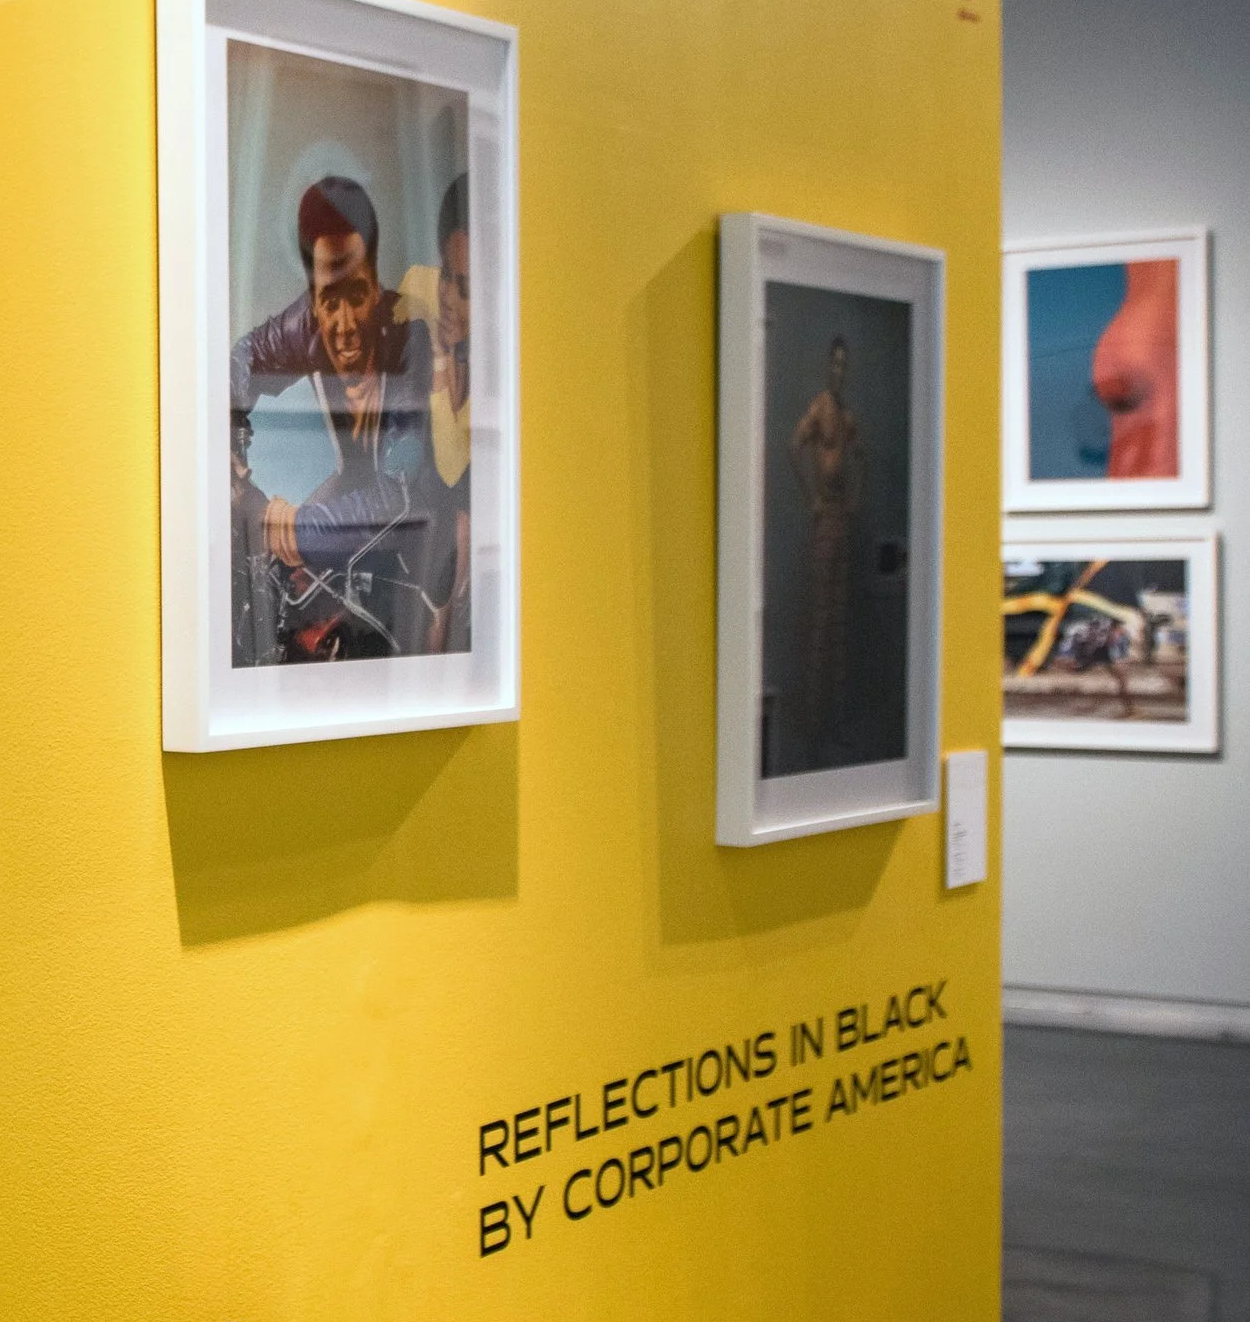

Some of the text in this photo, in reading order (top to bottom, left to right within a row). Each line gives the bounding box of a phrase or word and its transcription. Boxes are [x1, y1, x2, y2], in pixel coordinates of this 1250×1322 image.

[479, 981, 947, 1176] REFLECTIONS IN BLACK
[479, 1036, 973, 1258] BY CORPORATE AMERICA
